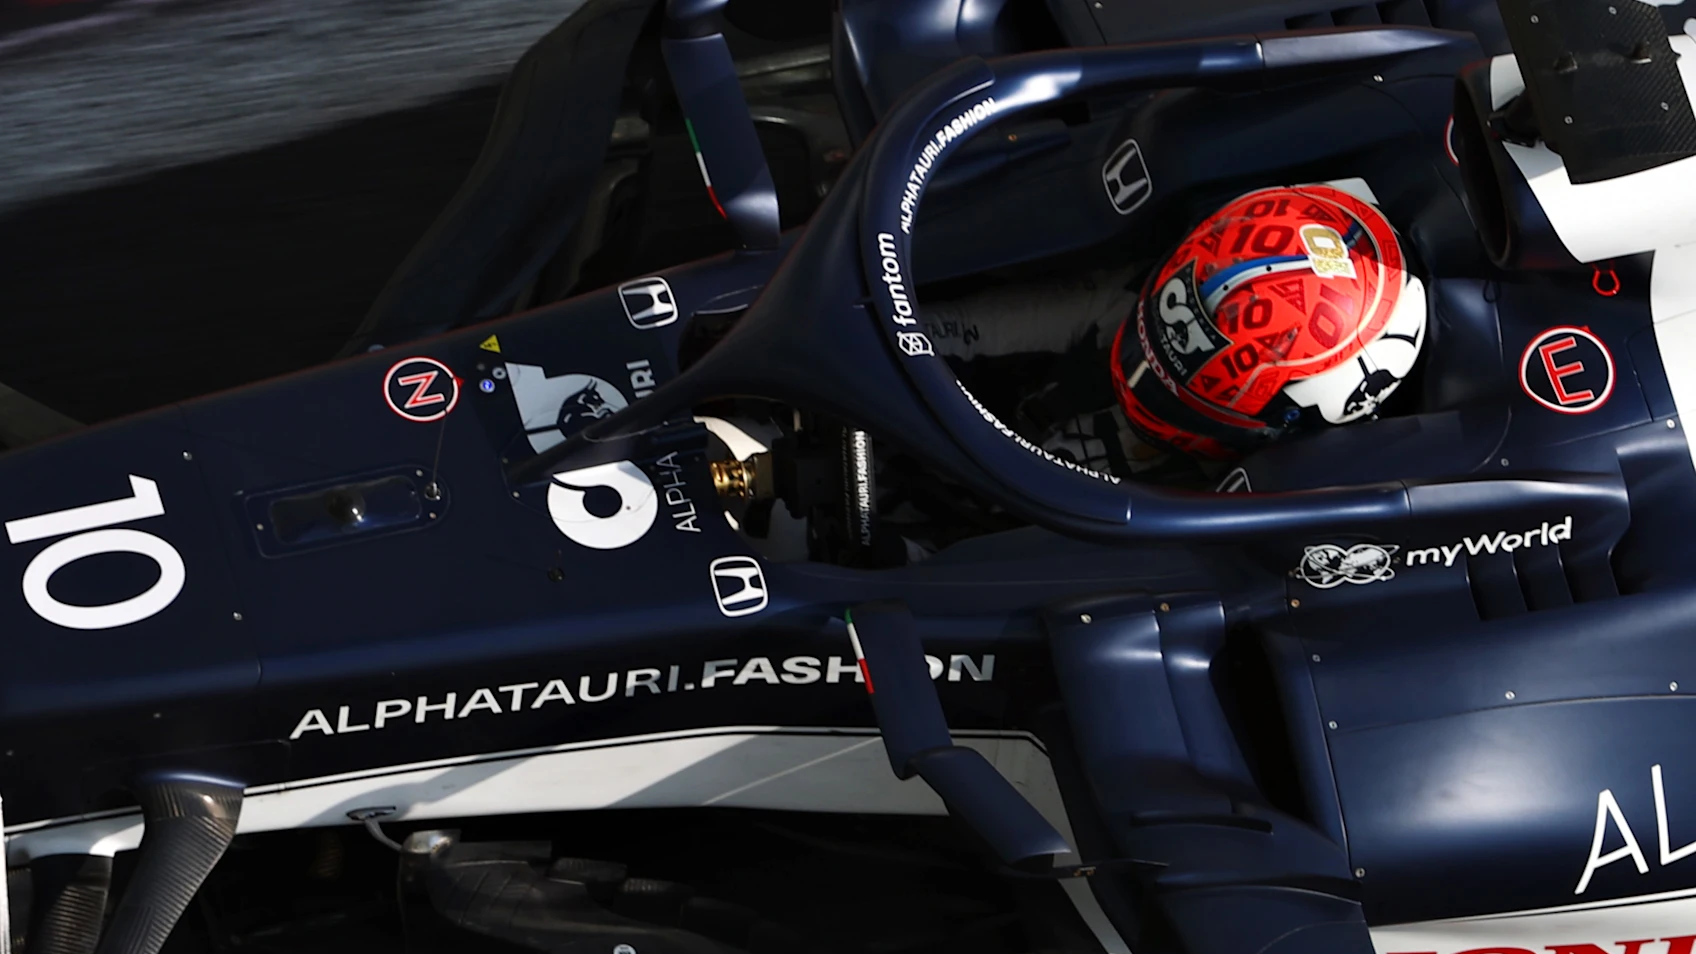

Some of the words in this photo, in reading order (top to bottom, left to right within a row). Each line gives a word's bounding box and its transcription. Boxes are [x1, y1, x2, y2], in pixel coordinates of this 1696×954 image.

[1232, 224, 1295, 254] 10
[878, 232, 917, 327] fantom
[1221, 343, 1260, 380] 10
[1538, 336, 1595, 405] E
[5, 473, 186, 631] 10
[1406, 515, 1573, 567] myWorld
[289, 653, 996, 740] ALPHATAURI.FASHN
